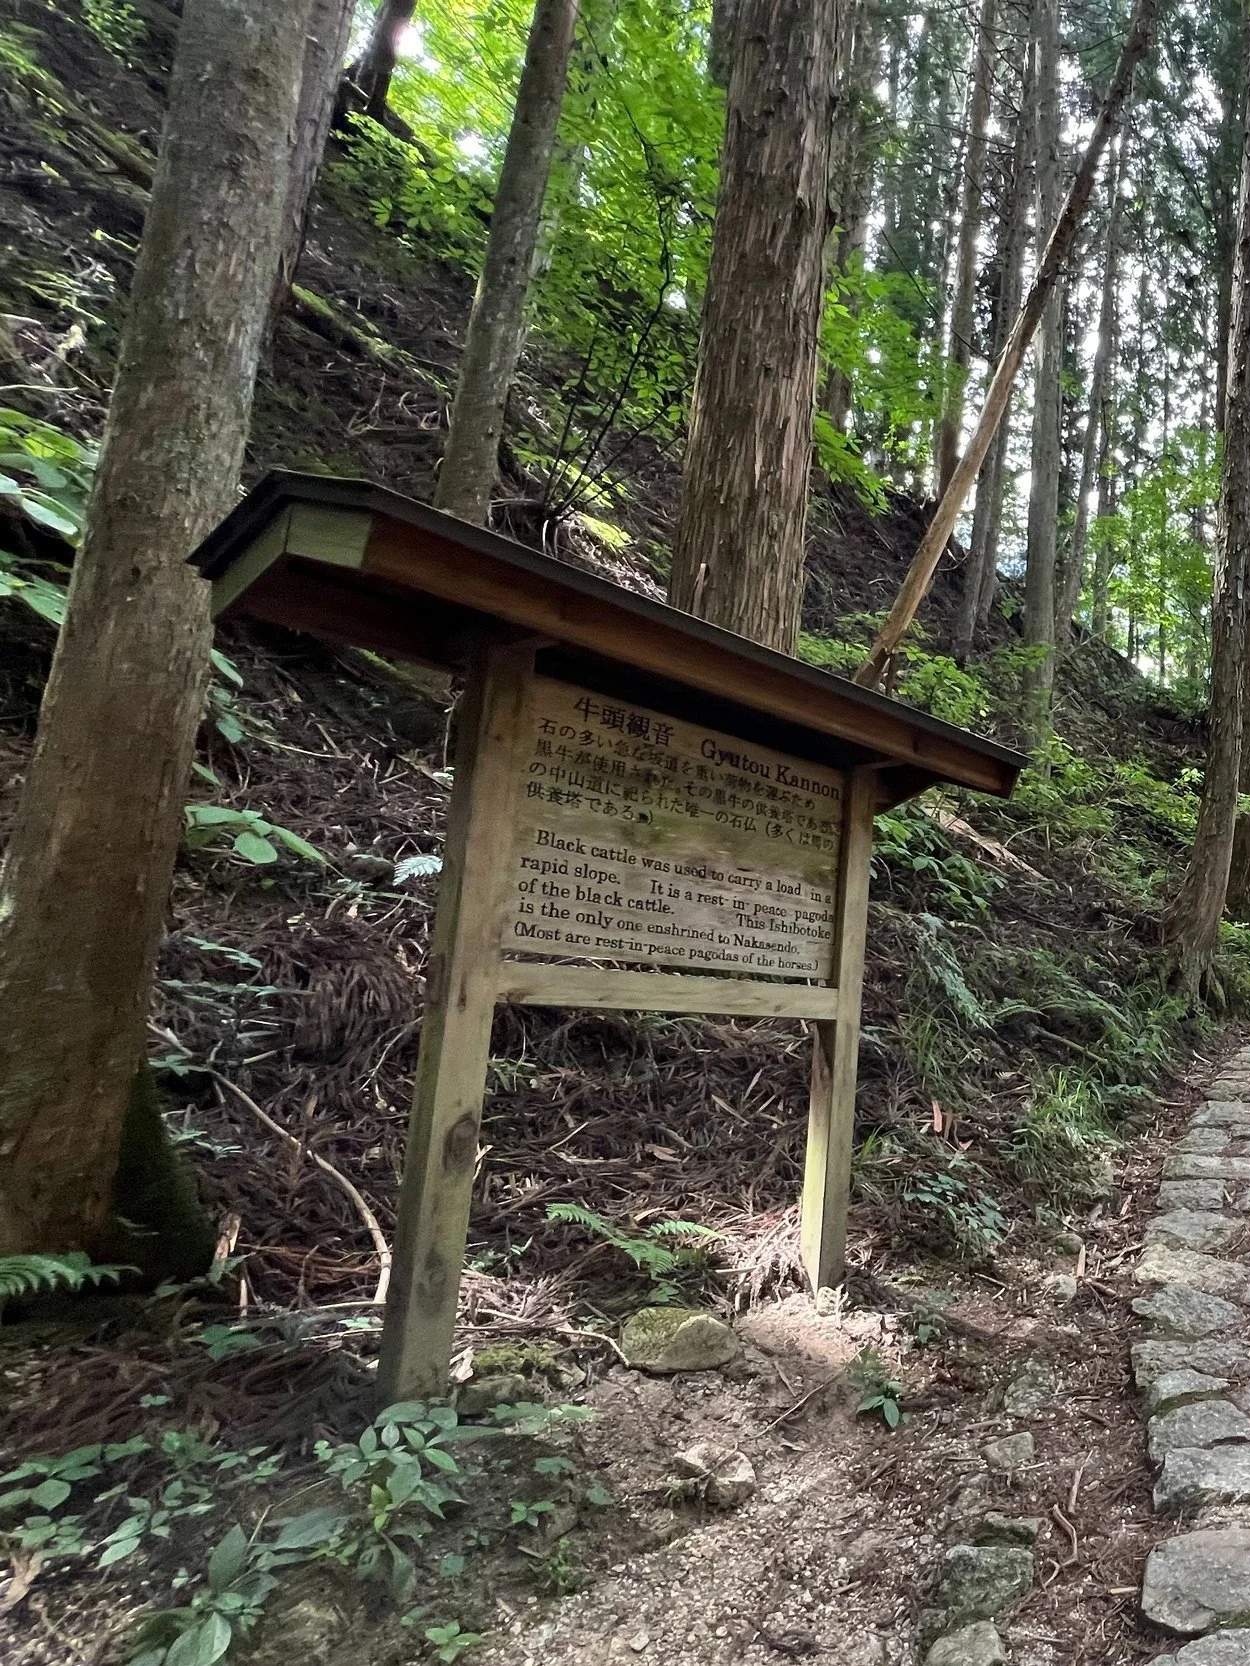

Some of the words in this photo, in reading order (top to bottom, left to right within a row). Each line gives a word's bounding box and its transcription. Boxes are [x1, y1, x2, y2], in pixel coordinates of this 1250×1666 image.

[574, 697, 675, 747] 牛頭観音
[701, 739, 770, 779] Gyutou
[776, 764, 840, 800] Kannon
[520, 856, 569, 875] rapid
[574, 863, 621, 884] slope.
[650, 879, 664, 895] It
[668, 883, 680, 899] is
[684, 890, 693, 901] a
[794, 908, 834, 924] pagoda
[536, 829, 586, 855] Black
[591, 848, 637, 865] cattle
[641, 857, 671, 873] was
[674, 865, 707, 879] used
[711, 869, 724, 882] to
[728, 873, 762, 891] carry
[765, 881, 773, 891] a
[776, 880, 801, 896] load
[810, 888, 822, 903] in
[825, 894, 832, 904] a
[518, 878, 539, 894] of
[541, 881, 570, 898] the
[627, 897, 675, 915] cattle.
[736, 913, 766, 930] This
[769, 918, 832, 940] Ishibotoke
[518, 897, 534, 914] is
[541, 902, 570, 920] the
[575, 911, 614, 929] only
[617, 919, 643, 931] one
[647, 923, 714, 942] enshrined
[718, 933, 730, 945] to
[732, 933, 800, 955] Nakasendo.
[514, 920, 561, 941] (Most
[565, 932, 591, 945] are
[688, 948, 739, 962] pagodas
[742, 952, 755, 964] of
[757, 954, 775, 967] the
[777, 959, 819, 972] horses.)
